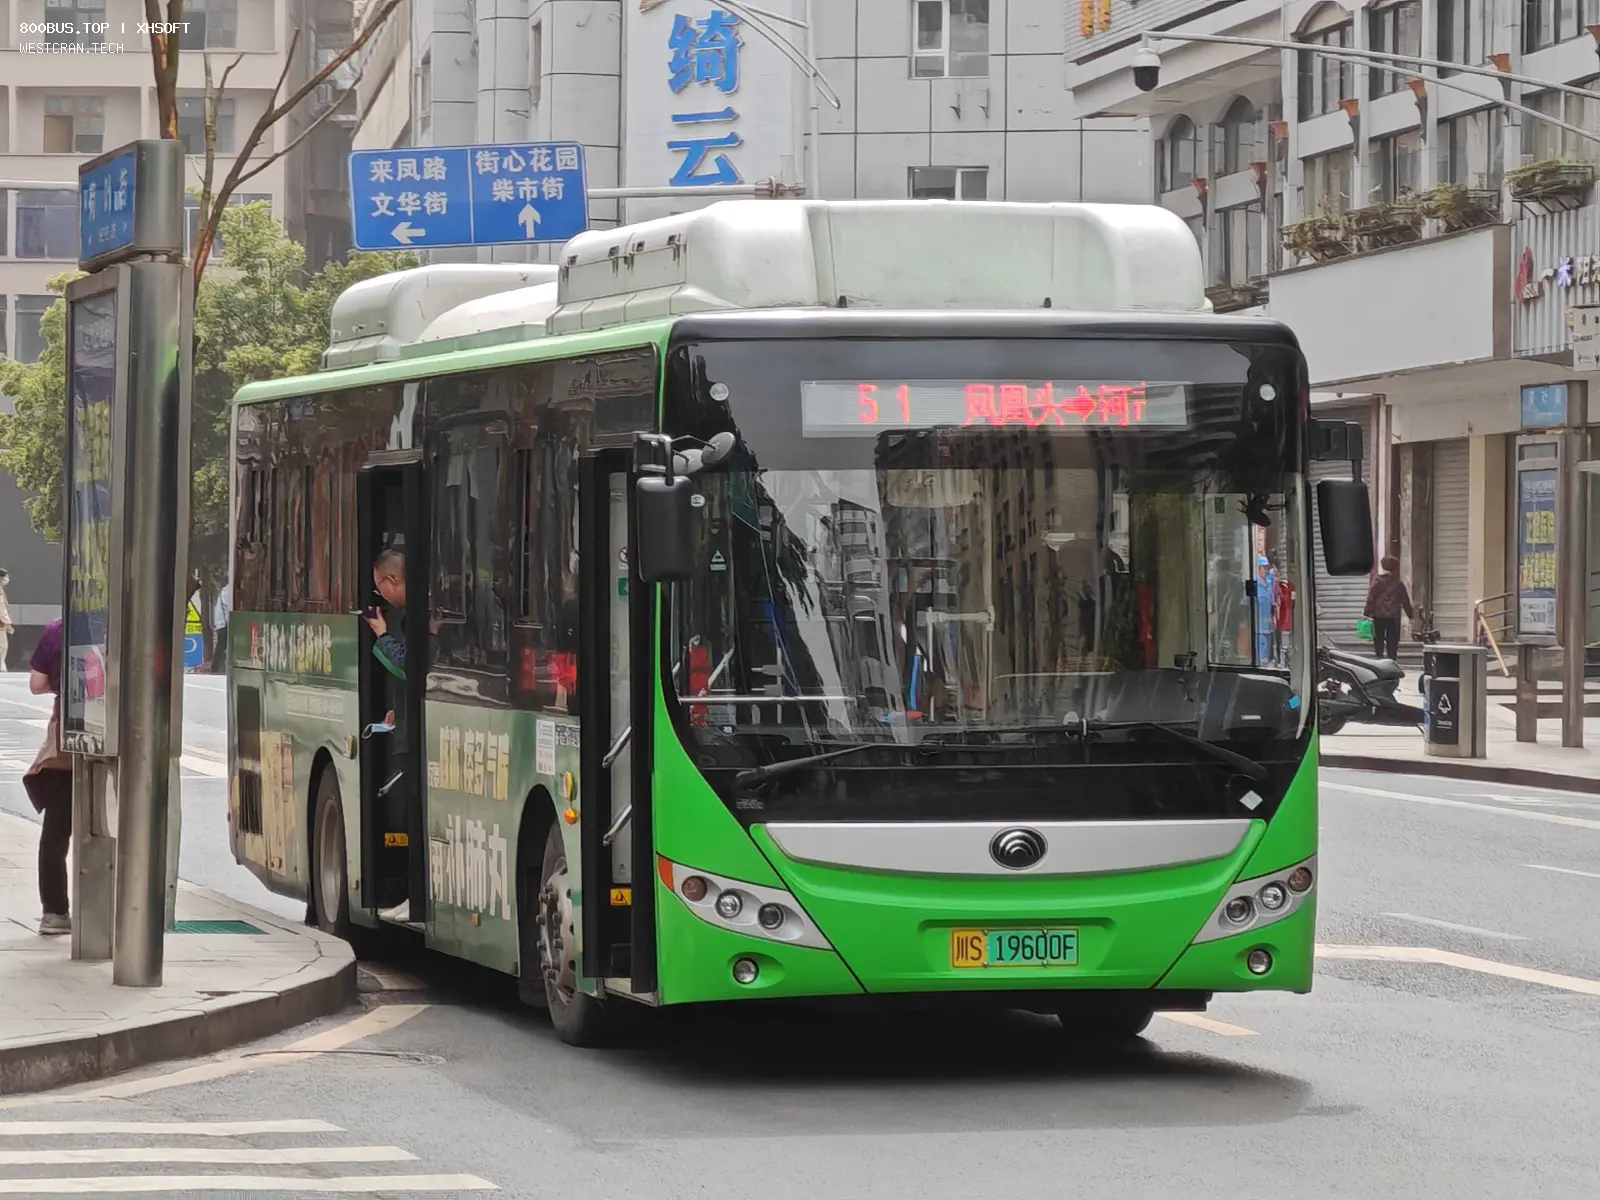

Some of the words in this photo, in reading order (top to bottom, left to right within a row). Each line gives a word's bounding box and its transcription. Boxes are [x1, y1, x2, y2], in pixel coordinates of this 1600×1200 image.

[369, 156, 448, 183] 来凤路
[475, 146, 579, 175] 街心花园
[492, 176, 565, 202] 柴市街
[370, 191, 448, 218] 文华街
[996, 934, 1075, 962] 19600F
